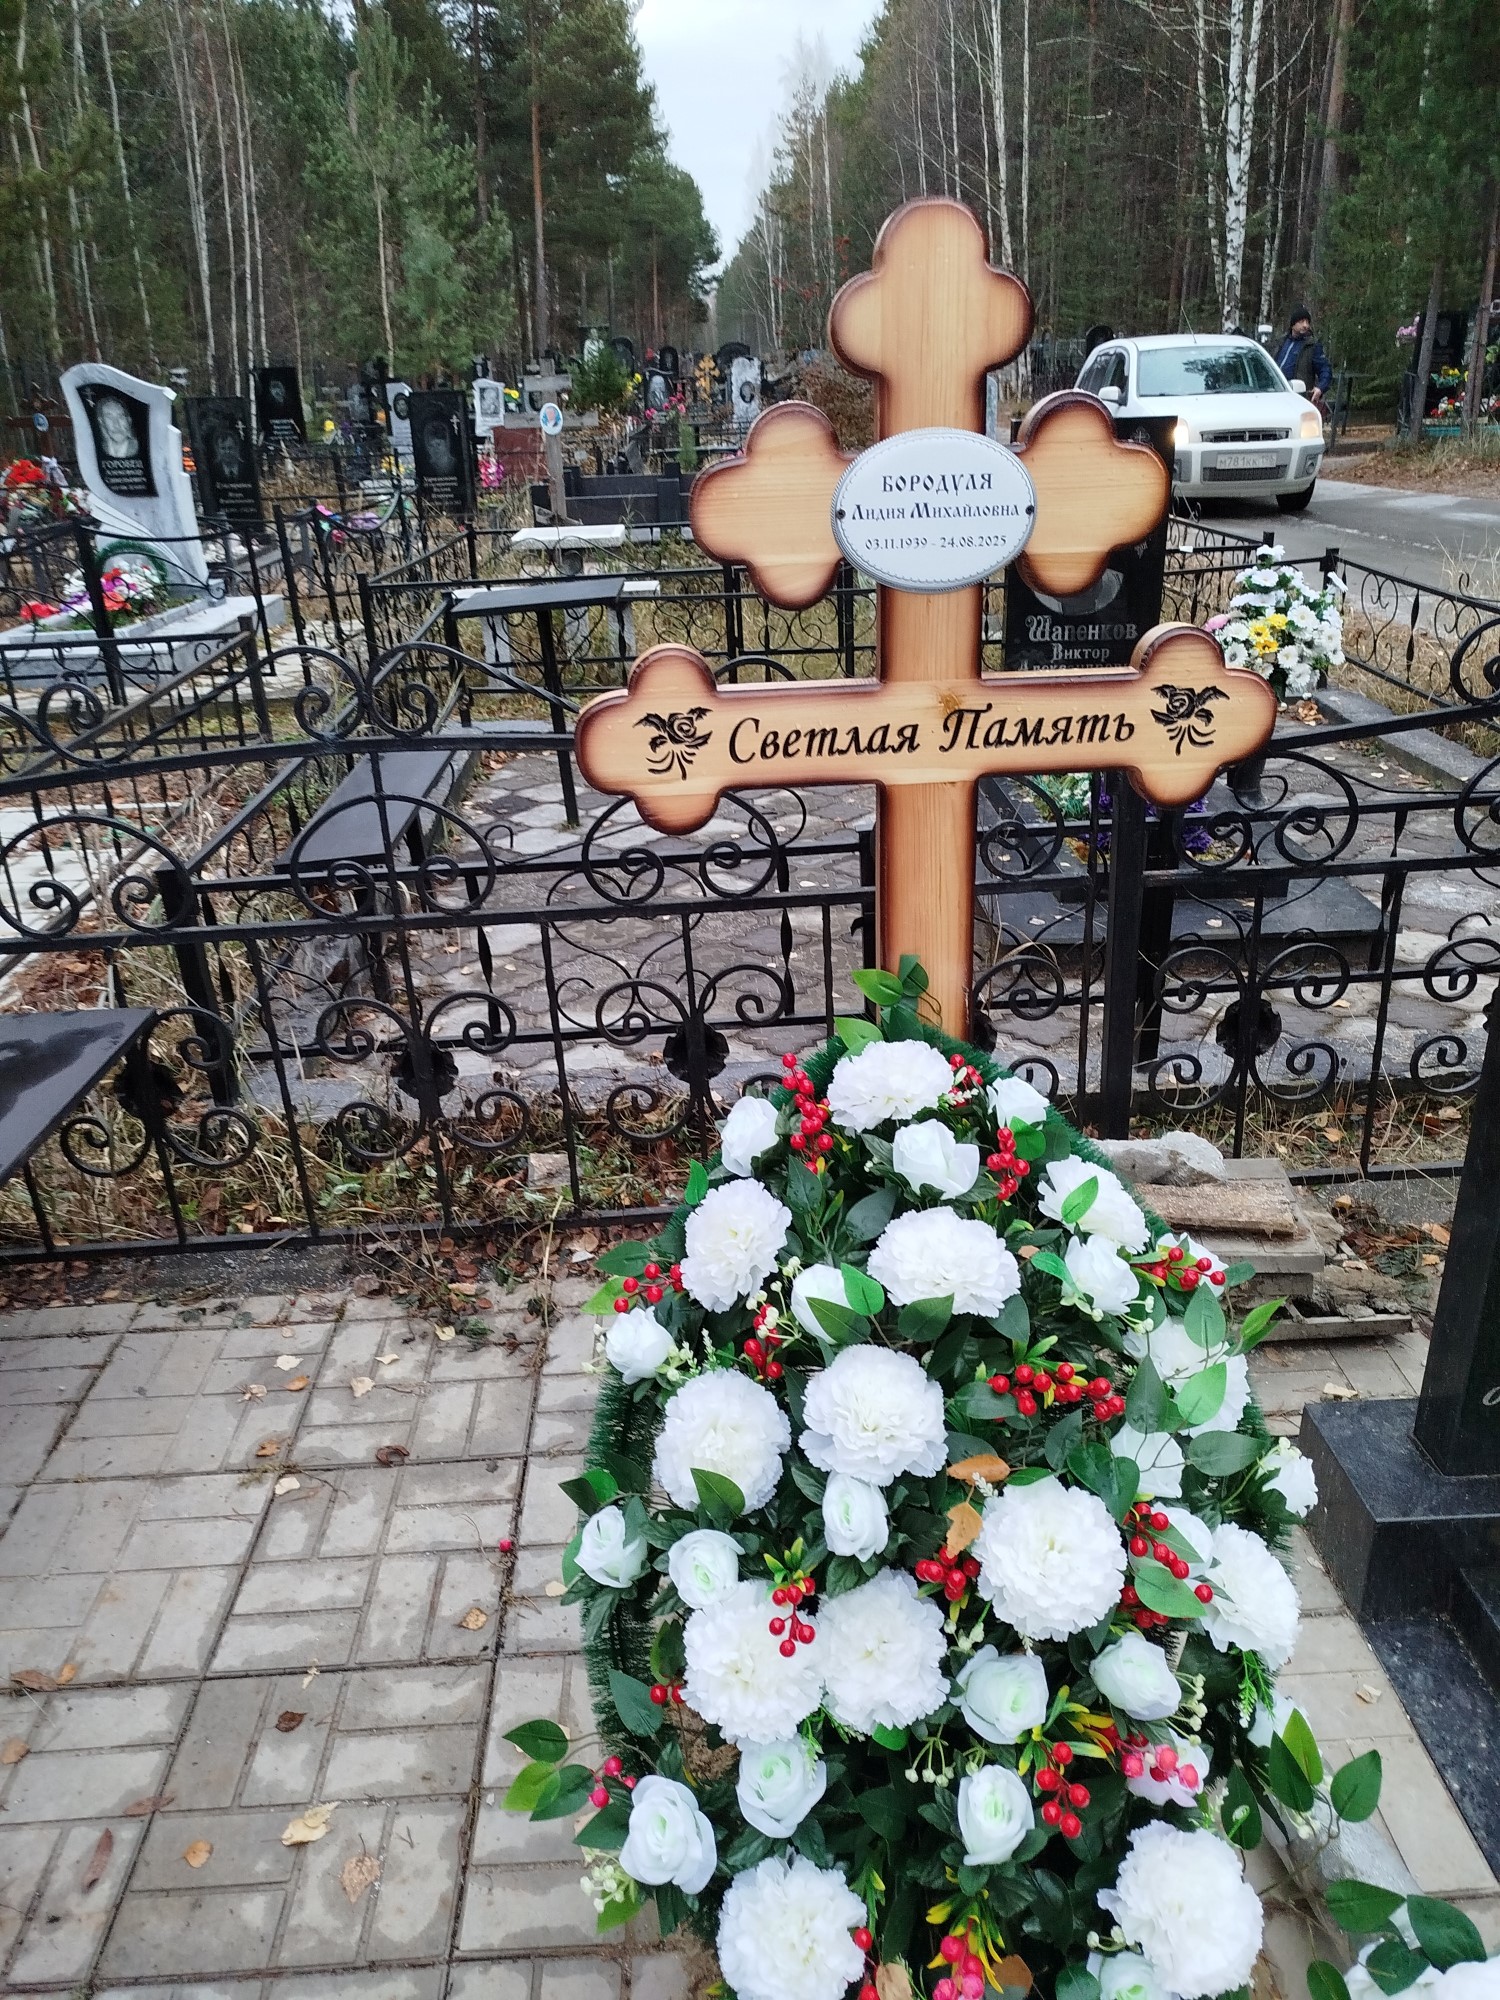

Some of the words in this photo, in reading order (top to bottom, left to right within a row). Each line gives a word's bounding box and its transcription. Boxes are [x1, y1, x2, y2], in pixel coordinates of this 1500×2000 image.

[881, 473, 993, 496] БОРОДУЛЯ
[852, 504, 905, 522] Лидия
[910, 501, 1020, 519] Михайловна
[865, 537, 928, 551] 03.11.1939
[940, 535, 1007, 548] 24.08.2025
[1025, 615, 1138, 642] Шапенков
[1051, 643, 1110, 663] Виктор
[728, 717, 920, 764] Светлая
[939, 703, 1136, 752] Память
